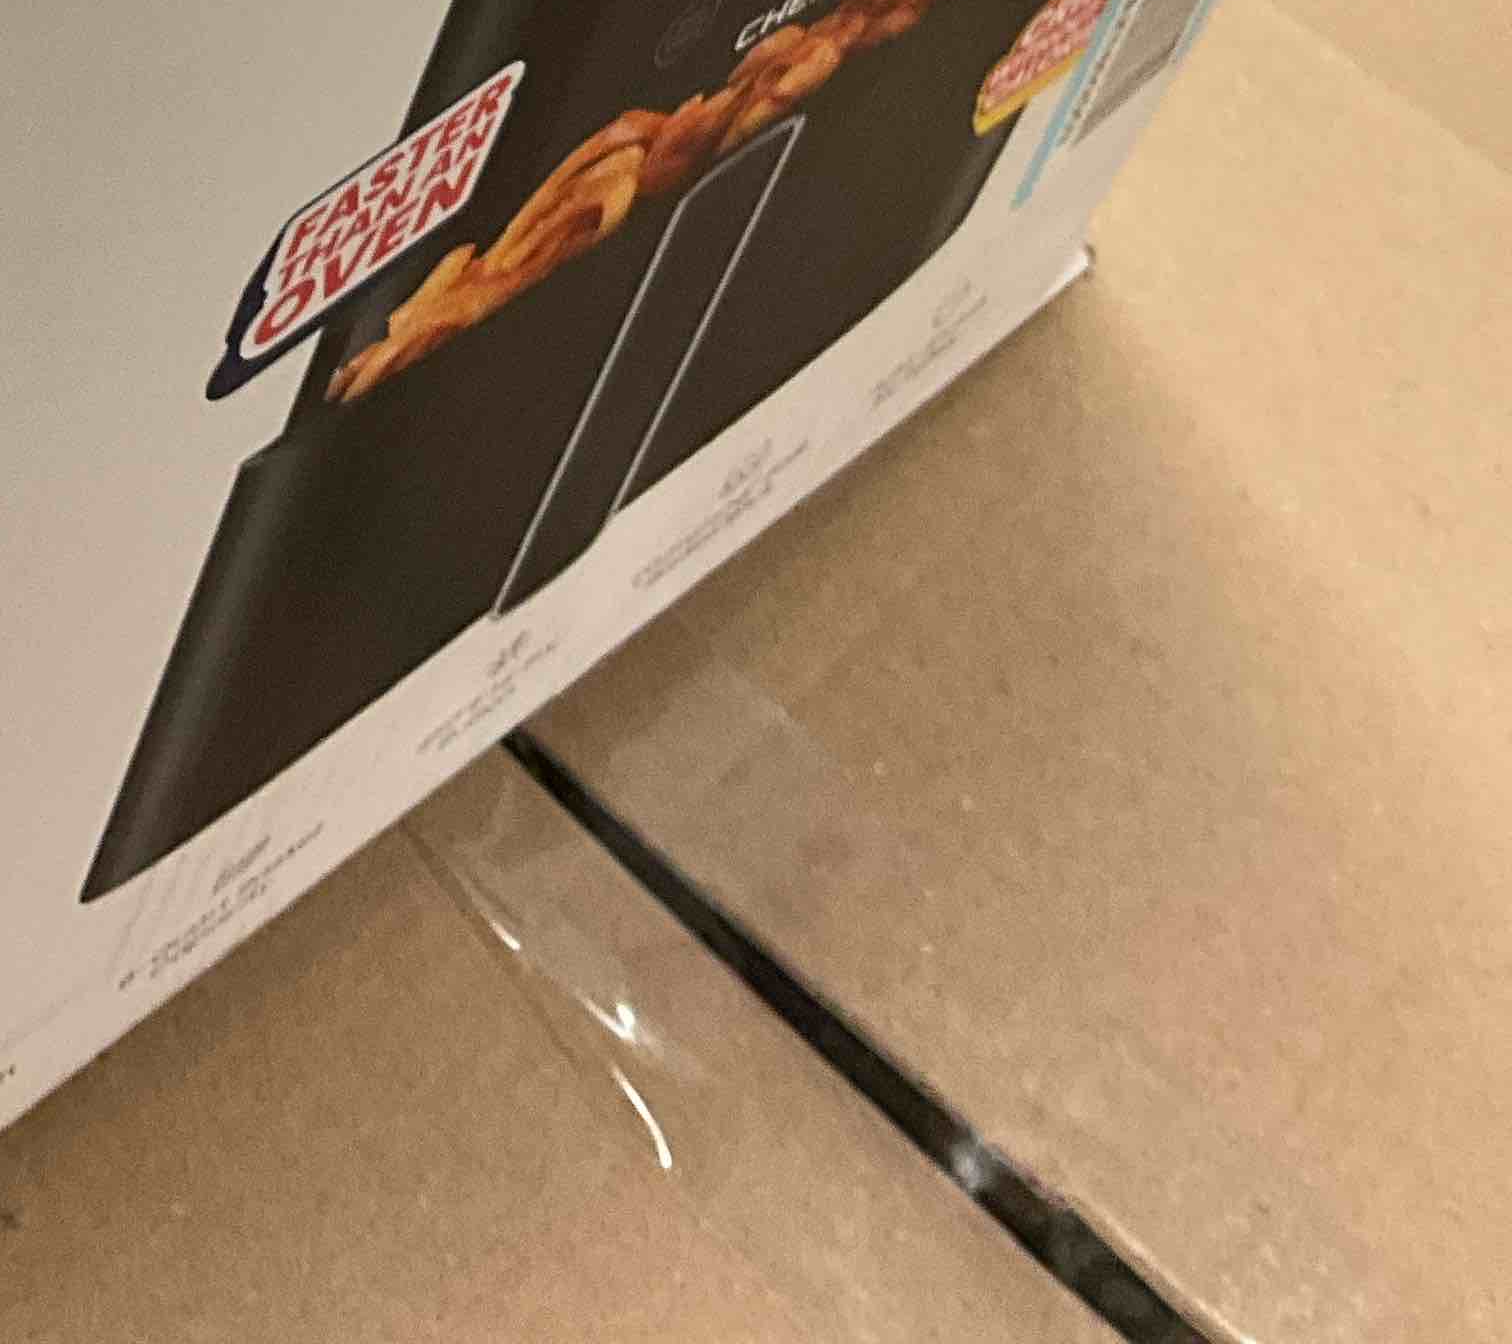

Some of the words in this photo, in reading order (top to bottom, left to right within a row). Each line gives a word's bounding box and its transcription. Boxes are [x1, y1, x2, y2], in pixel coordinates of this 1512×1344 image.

[254, 157, 475, 346] OVEN
[279, 168, 416, 291] THAN
[421, 113, 497, 191] AN
[285, 74, 512, 263] FASTER
